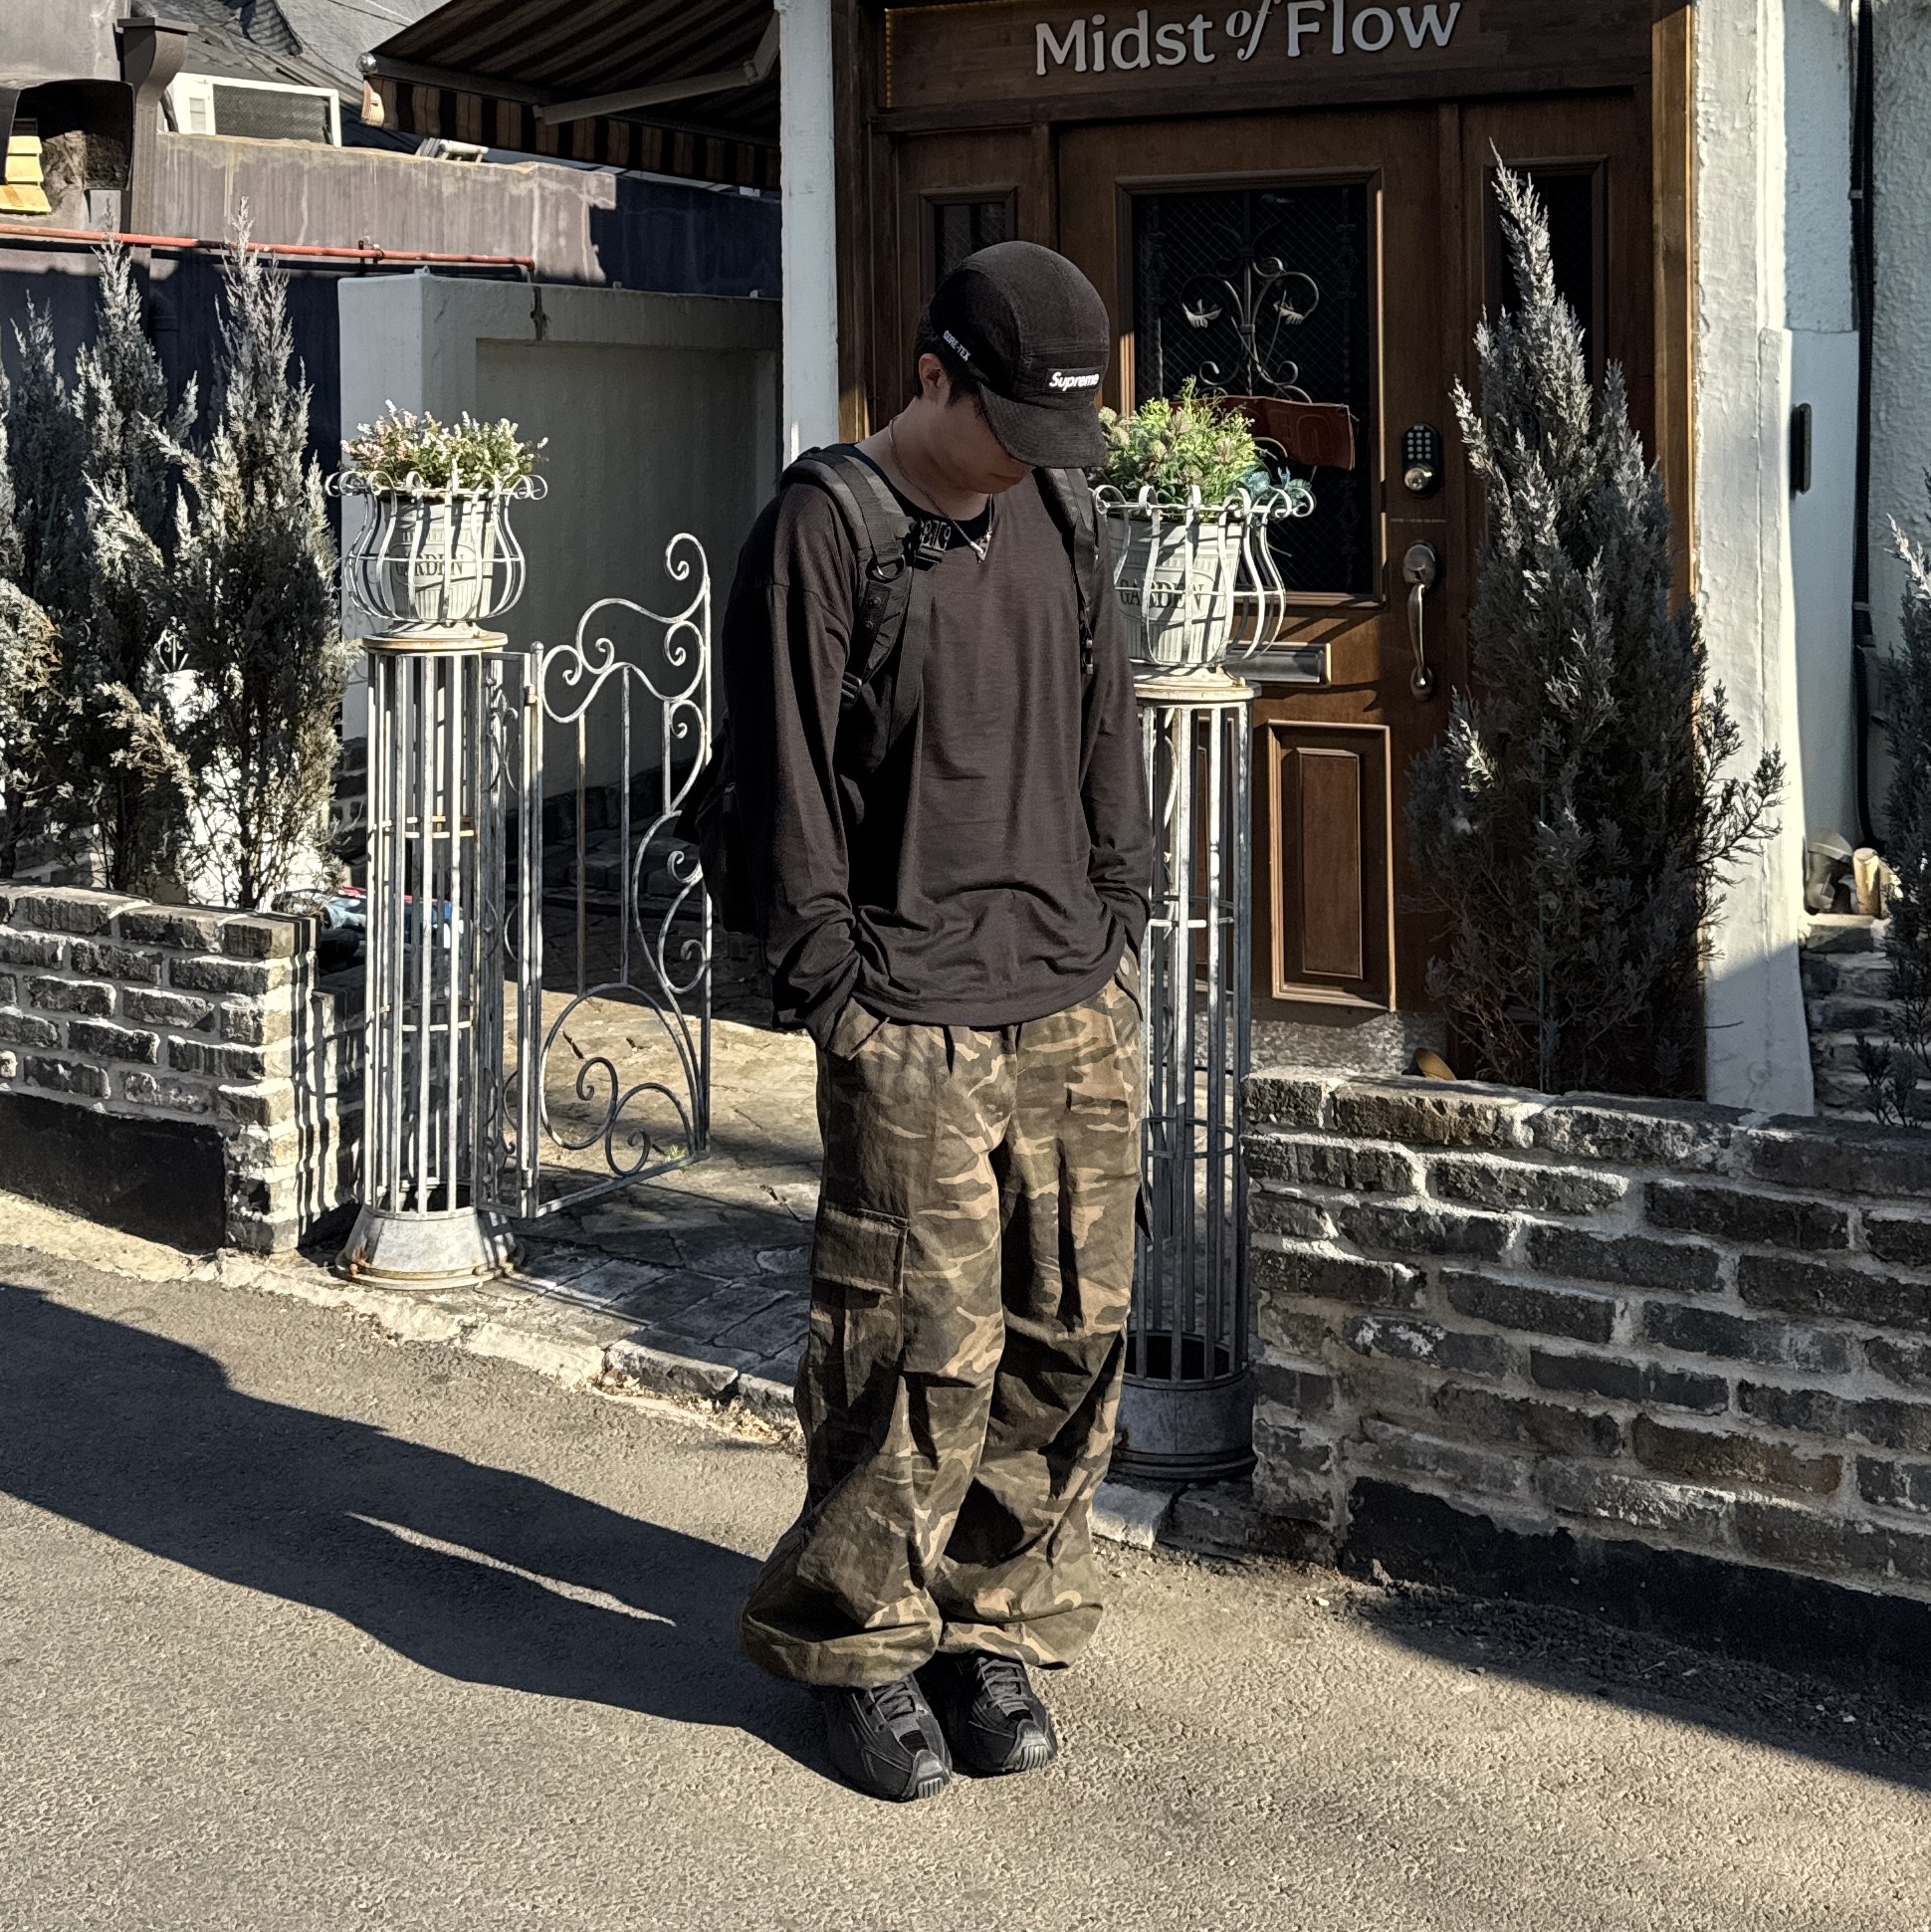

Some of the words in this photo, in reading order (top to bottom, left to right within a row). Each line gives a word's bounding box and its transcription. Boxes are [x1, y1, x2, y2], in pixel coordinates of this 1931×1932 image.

[1034, 9, 1215, 76] Midst
[1225, 0, 1282, 61] of
[1287, 0, 1461, 57] Flow
[1048, 371, 1100, 392] Supreme
